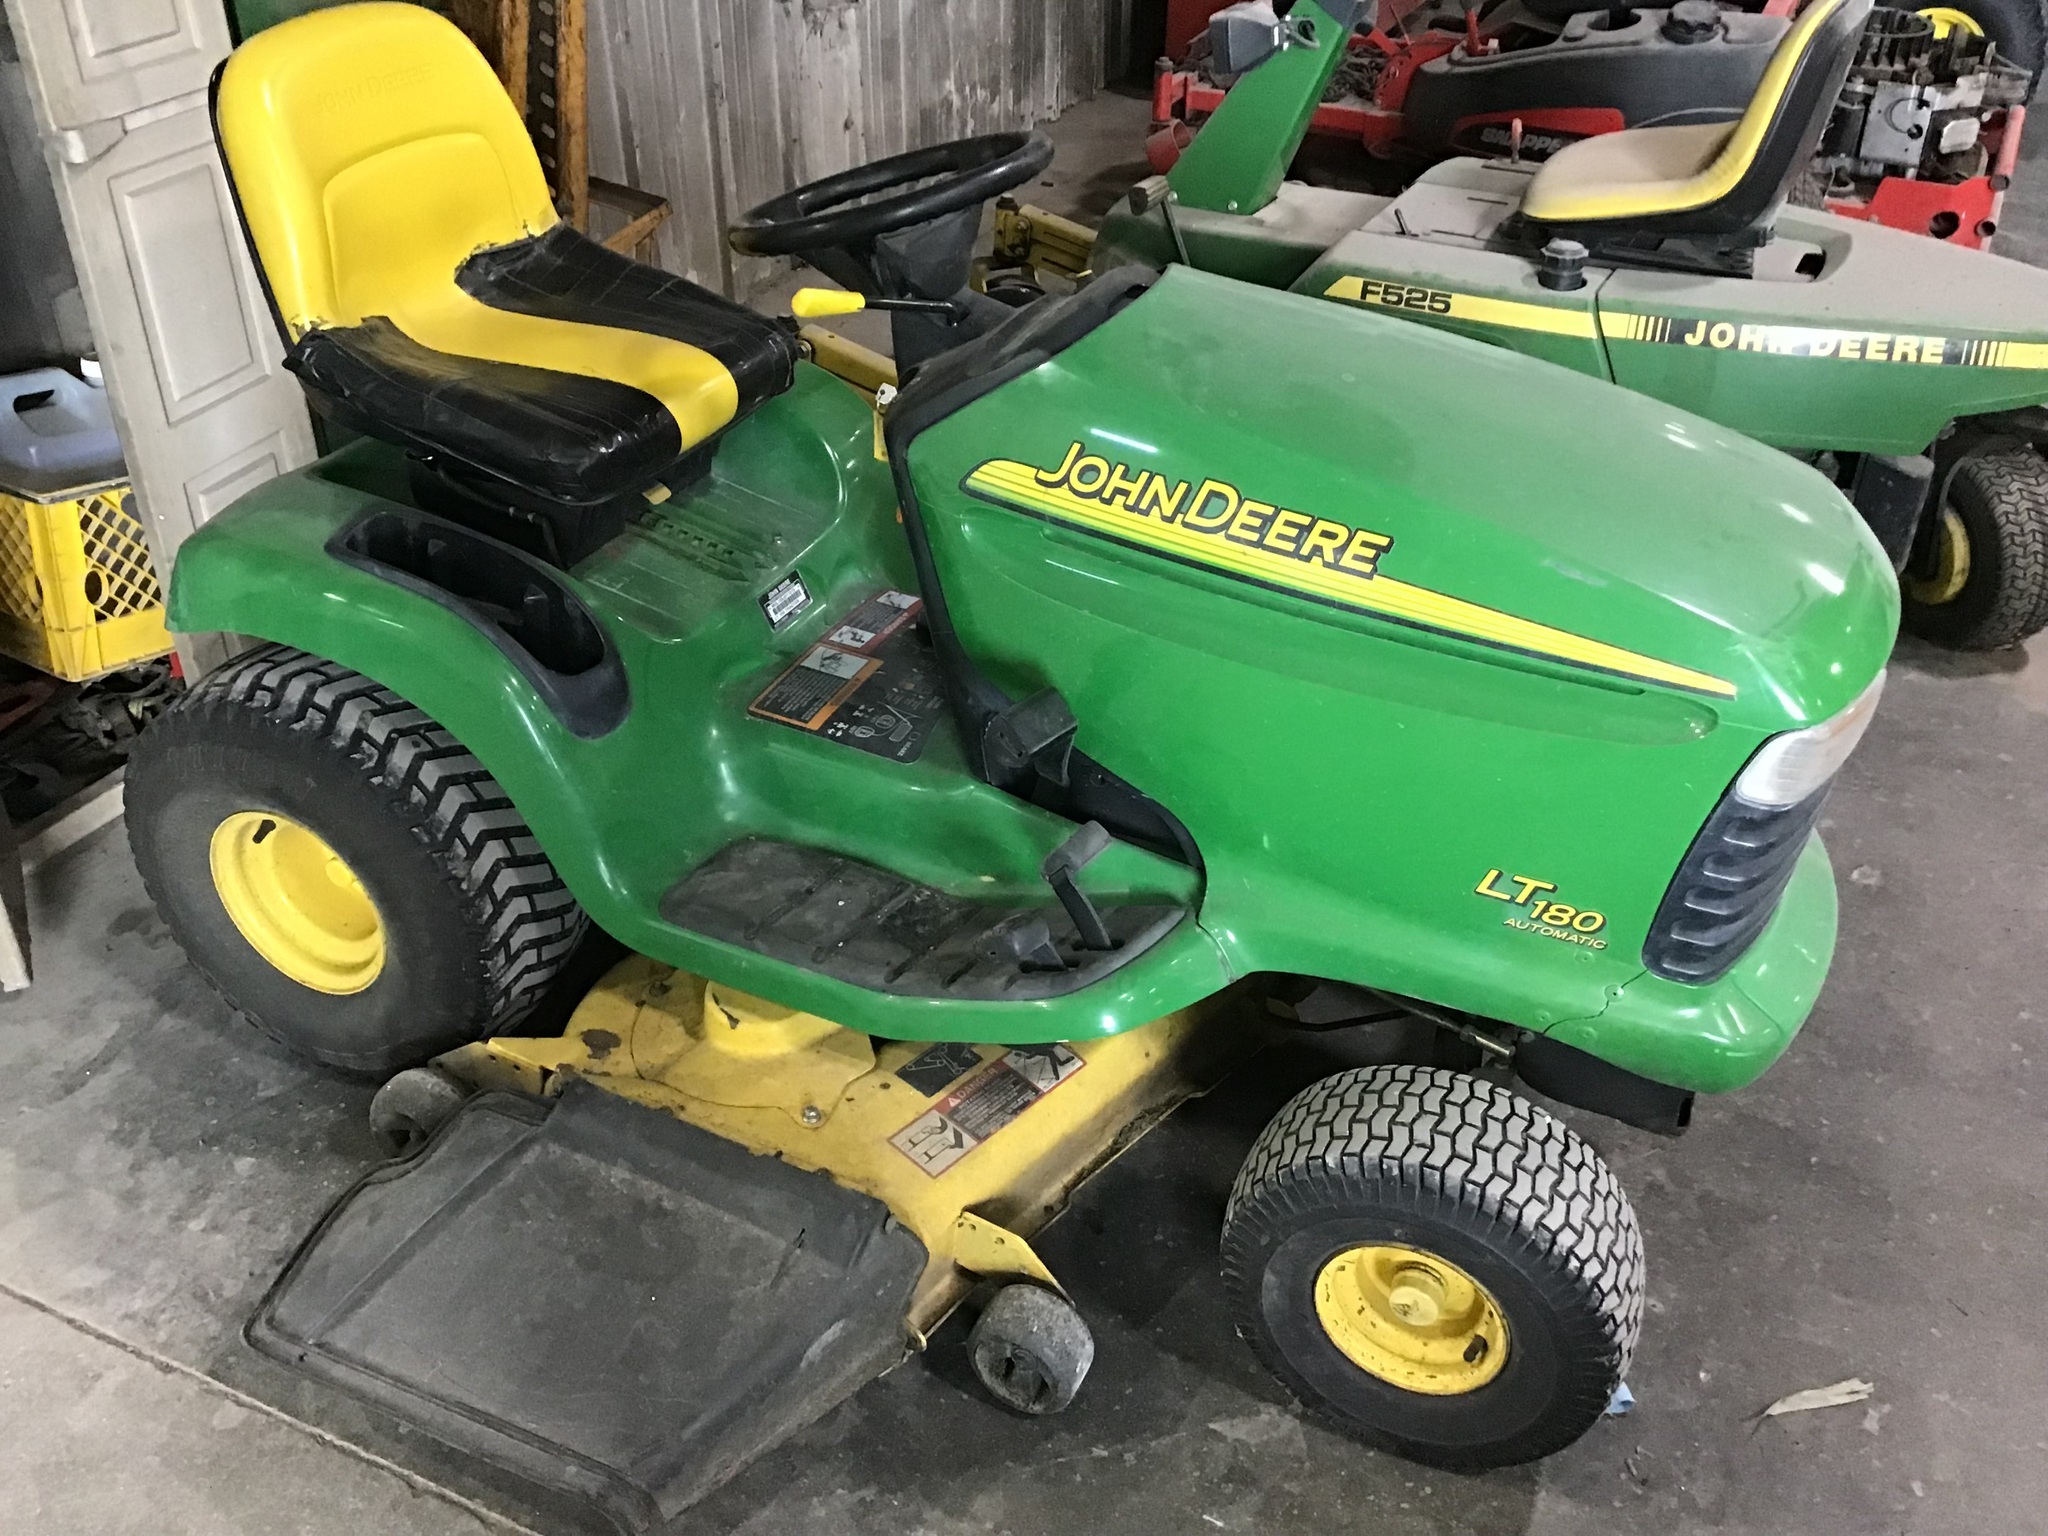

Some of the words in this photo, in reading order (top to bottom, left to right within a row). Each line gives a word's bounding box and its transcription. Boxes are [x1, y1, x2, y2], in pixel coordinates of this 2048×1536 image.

[1360, 280, 1452, 314] F525
[1809, 331, 1946, 364] DEERE
[1035, 441, 1190, 523] JOHN
[1179, 478, 1394, 580] DEERE
[1503, 917, 1608, 950] AUTOMATIC
[957, 1068, 999, 1098] DANGER
